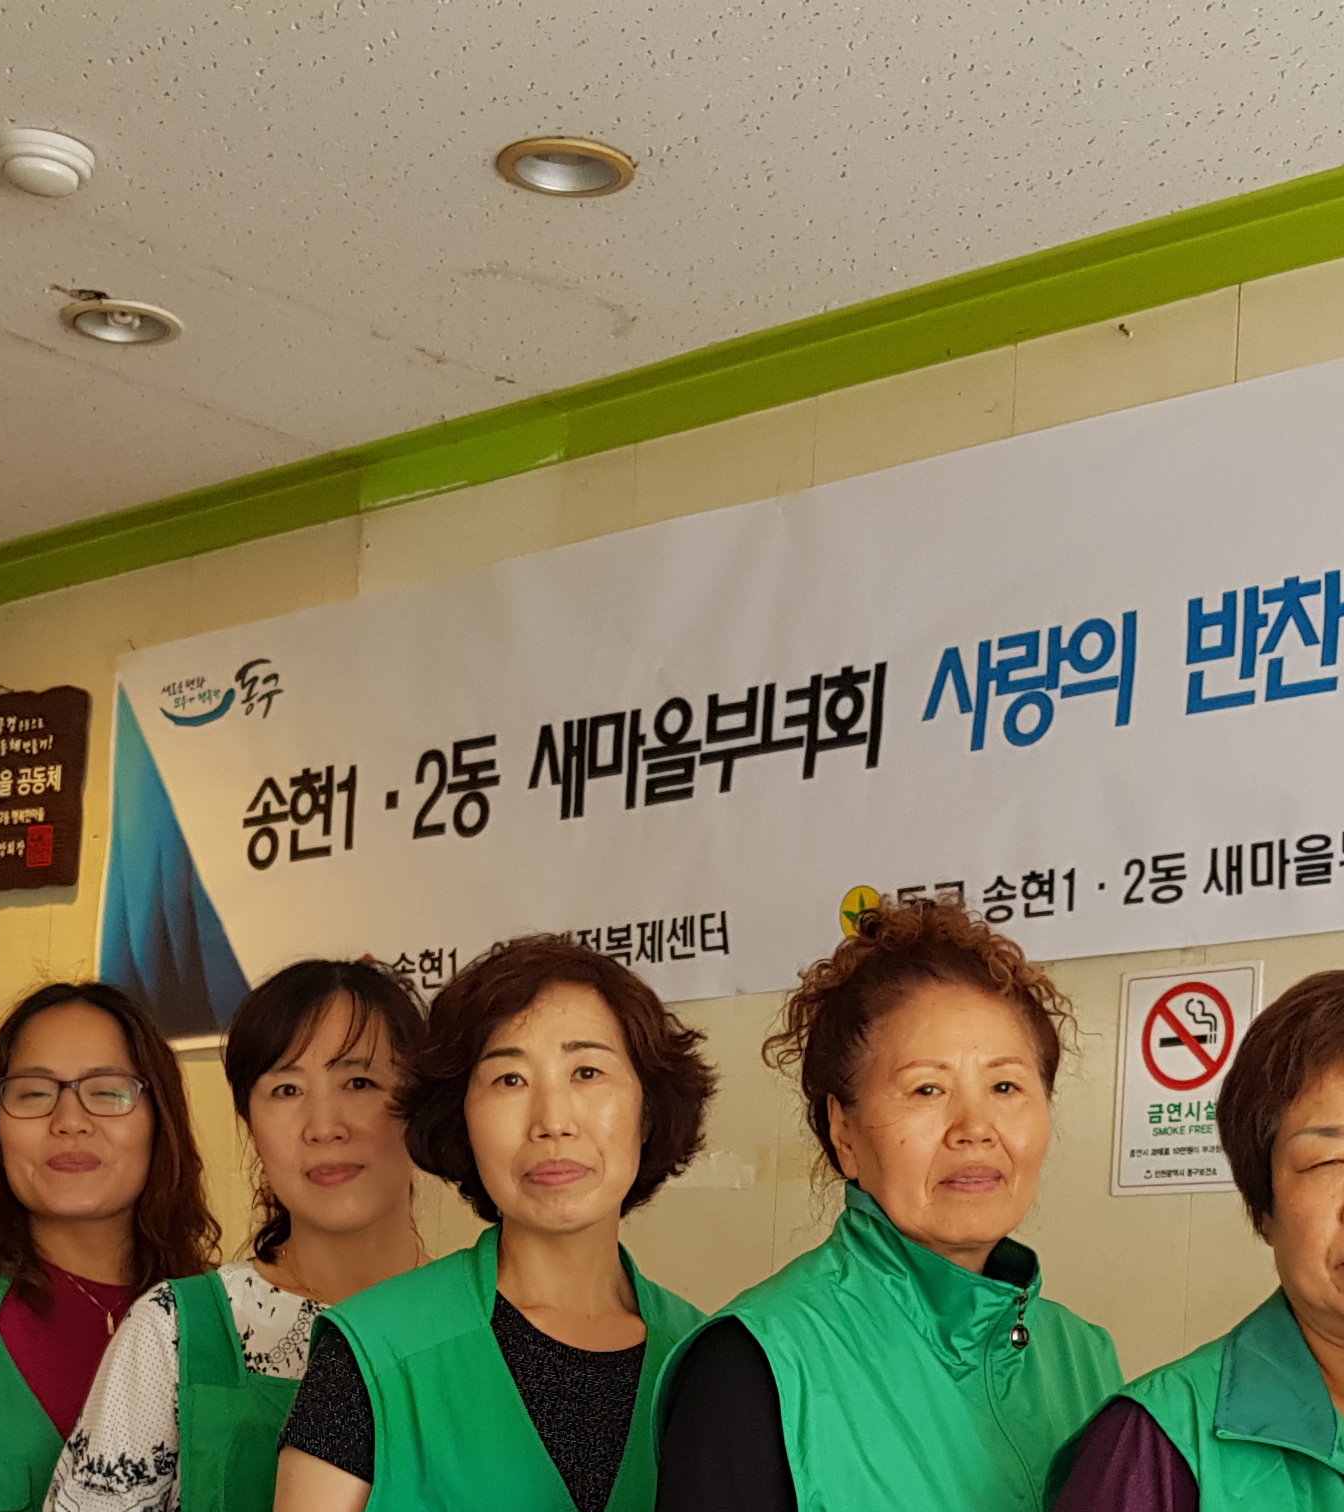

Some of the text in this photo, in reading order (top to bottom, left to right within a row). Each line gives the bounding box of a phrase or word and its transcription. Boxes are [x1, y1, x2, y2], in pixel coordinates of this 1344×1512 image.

[234, 658, 285, 720] 동구
[527, 662, 888, 821] 새마을부녀회
[921, 609, 1138, 752] 사랑의
[17, 763, 63, 796] 공동체
[1147, 1100, 1217, 1124] 금연시설
[1152, 1124, 1214, 1137] SMOKE FREE
